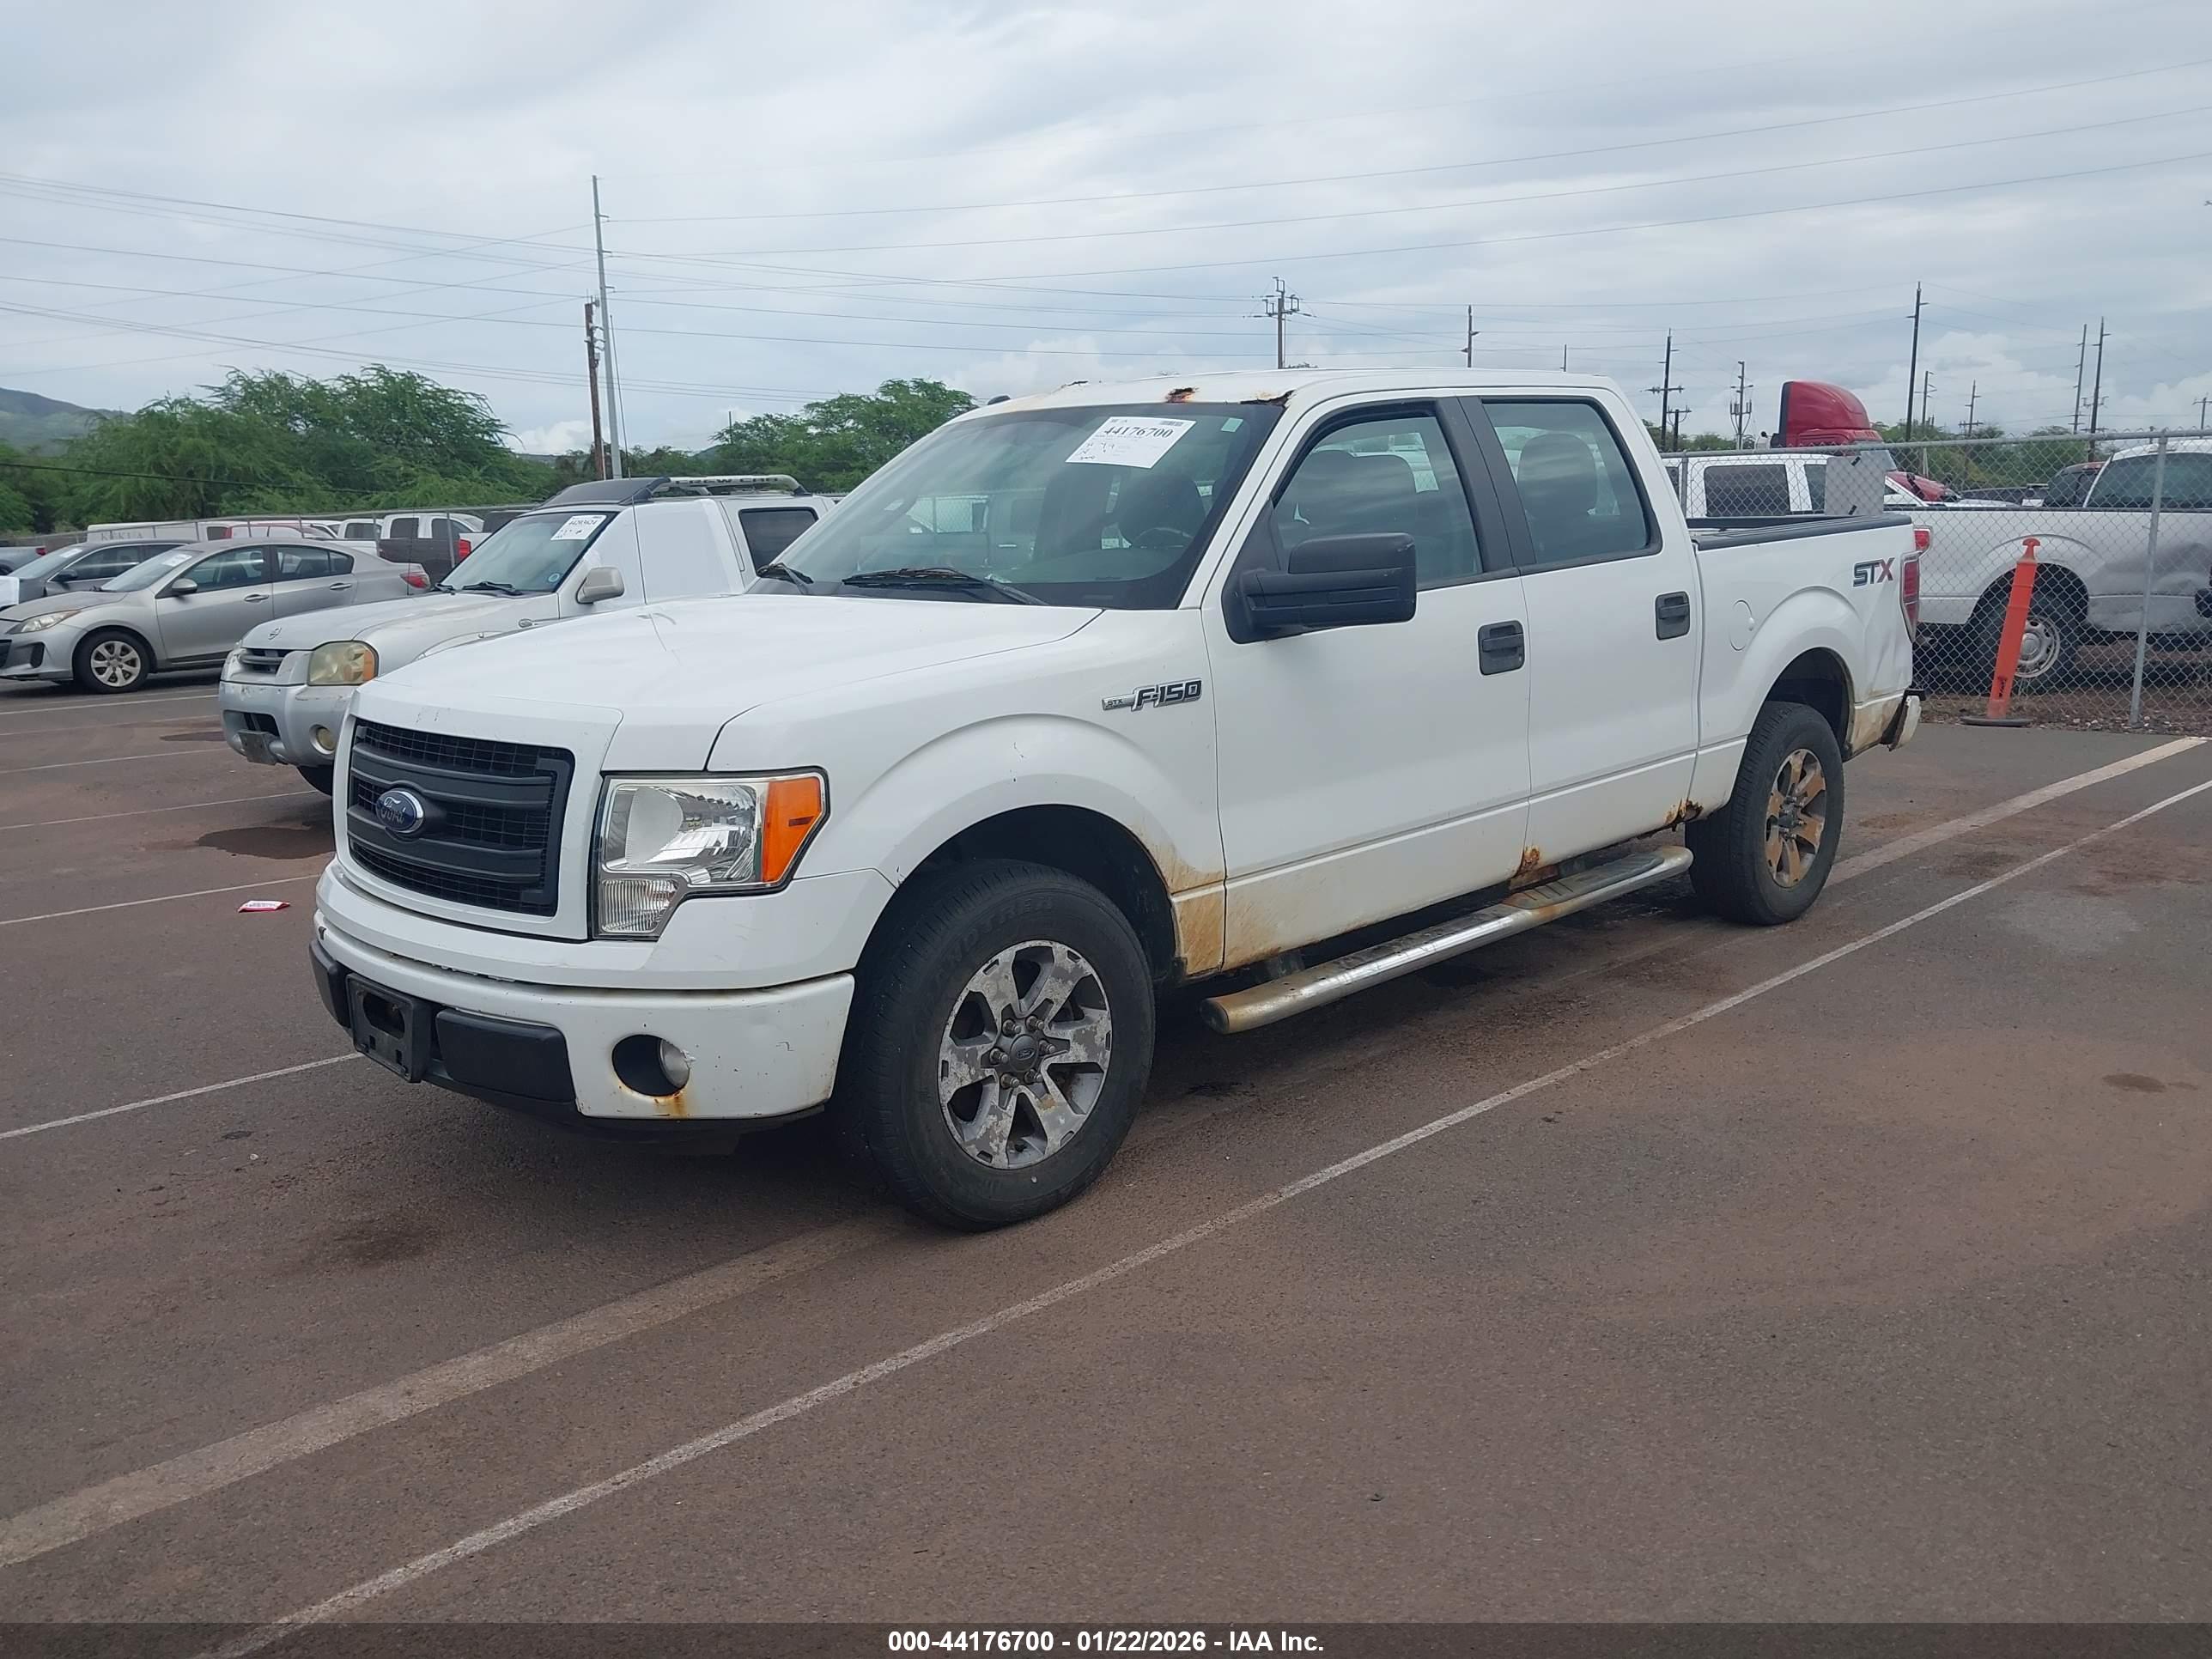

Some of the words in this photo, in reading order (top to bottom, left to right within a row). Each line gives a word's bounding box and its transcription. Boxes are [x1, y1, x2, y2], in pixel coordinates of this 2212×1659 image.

[1103, 426, 1175, 439] 44176700
[1852, 556, 1895, 587] STX
[1133, 678, 1202, 709] F-150
[381, 796, 407, 824] Ford
